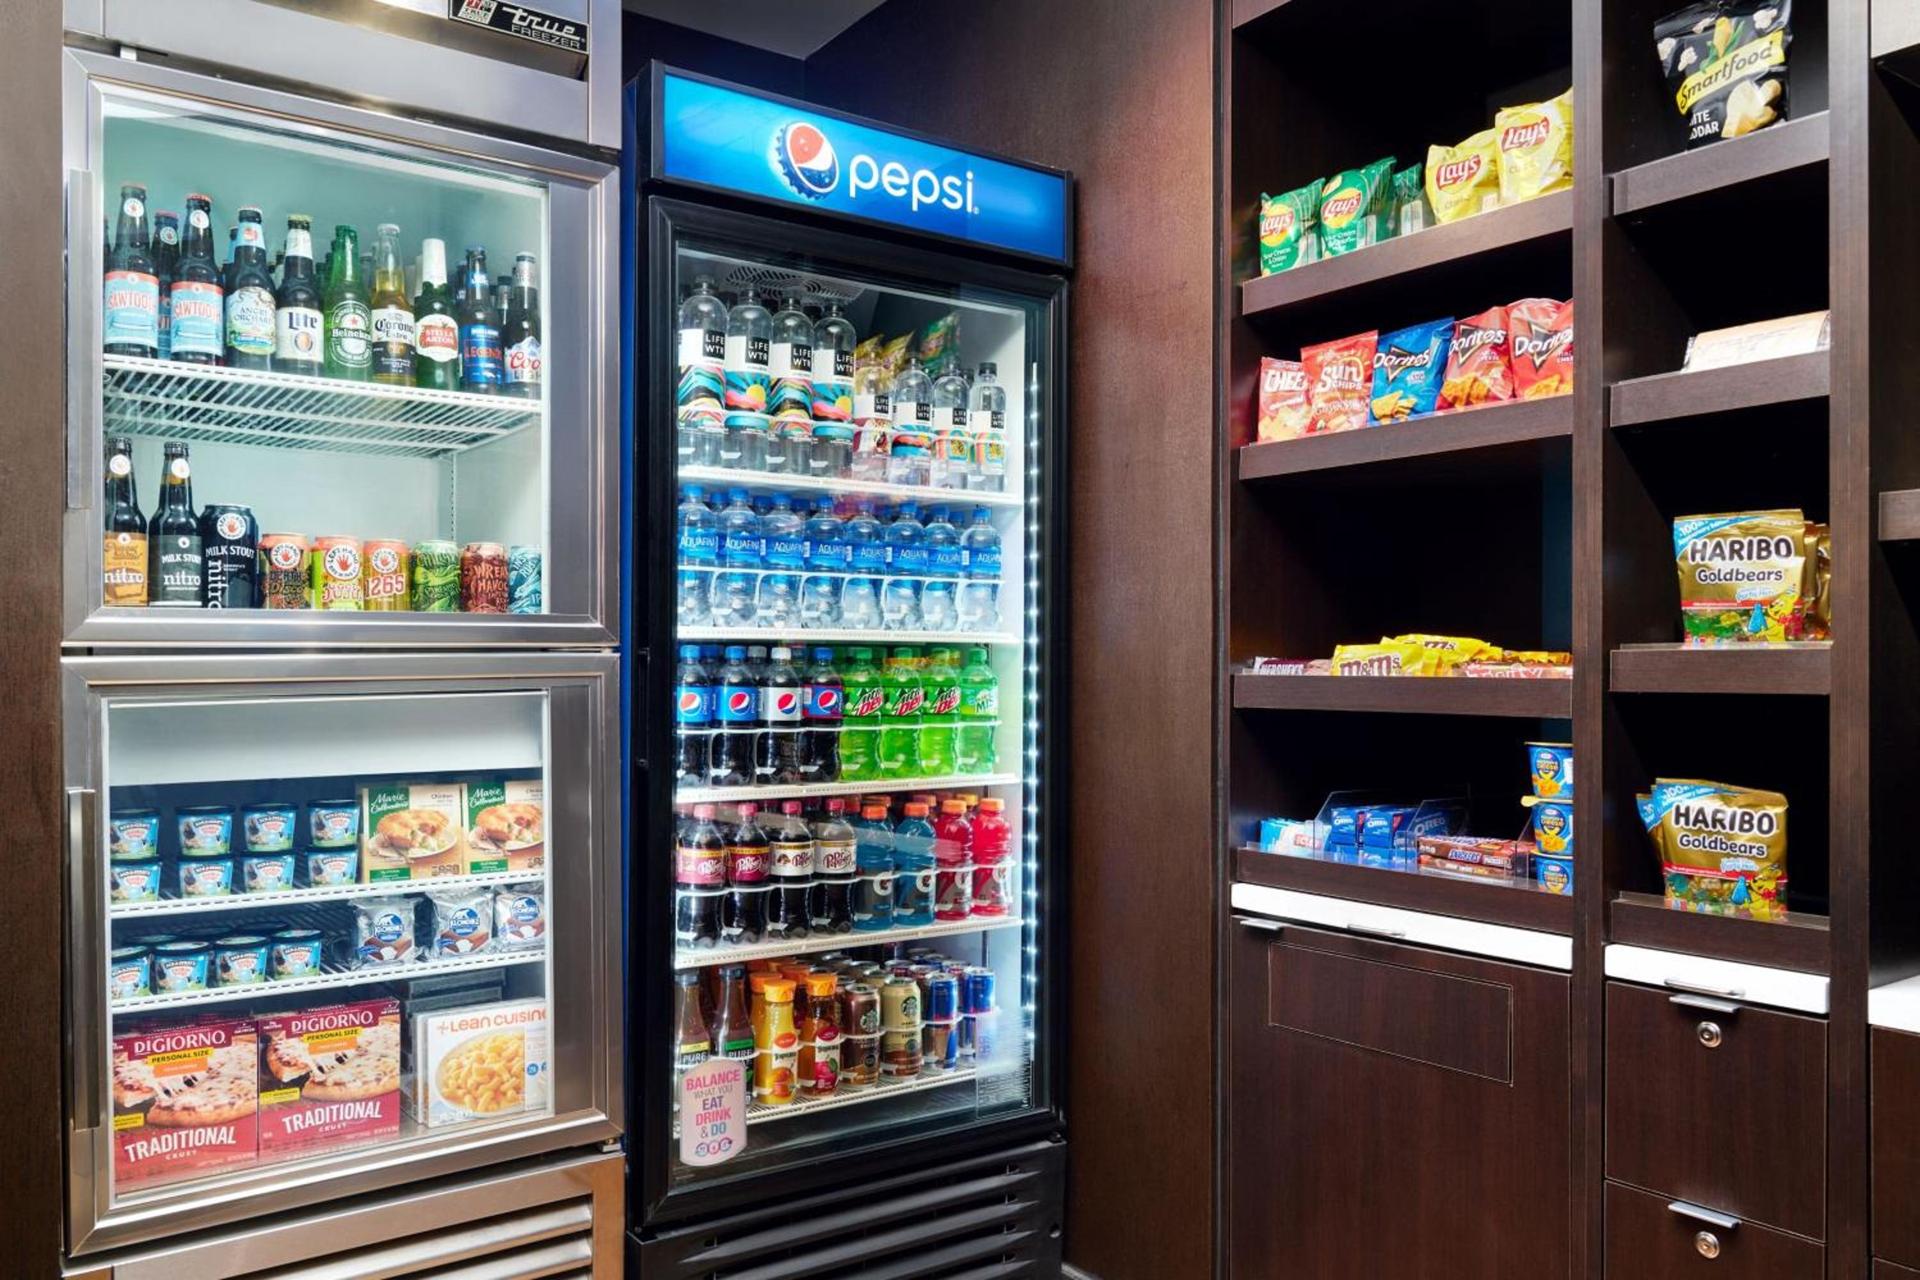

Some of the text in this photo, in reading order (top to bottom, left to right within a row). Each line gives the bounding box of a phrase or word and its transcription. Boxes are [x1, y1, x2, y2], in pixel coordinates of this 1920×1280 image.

[511, 24, 580, 49] FREEZER
[1680, 42, 1774, 110] Smartfood
[1690, 110, 1711, 126] ITE
[849, 154, 974, 215] pepsi
[288, 312, 318, 330] Lite
[705, 333, 725, 345] LIFE
[748, 340, 769, 350] LIFE
[793, 347, 811, 358] LIFE
[836, 353, 854, 364] LIFE
[1374, 349, 1431, 369] Doritos
[206, 545, 255, 559] MILK STOUT
[1690, 537, 1793, 563] HARIBO
[161, 554, 182, 564] MILK
[104, 569, 144, 584] nitro
[163, 570, 201, 586] nitro
[1698, 568, 1784, 583] Goldbears
[208, 560, 229, 609] nitro
[365, 575, 405, 598] 1265
[1674, 804, 1775, 835] HARIBO
[1679, 834, 1766, 857] Goldbears
[290, 1010, 374, 1034] DIGIORNO
[133, 1029, 226, 1057] DIGIORNO
[307, 1028, 360, 1042] PERSONAL SIZE
[151, 1048, 211, 1064] PERSONAL SIZE
[683, 1051, 707, 1064] PURE
[686, 1069, 741, 1091] BALANCE
[694, 1084, 733, 1099] WHAT YOU
[702, 1096, 724, 1111] EAT
[282, 1100, 382, 1135] TRADITIONAL
[695, 1107, 732, 1126] DRINK
[319, 1121, 347, 1134] CRUST
[701, 1122, 727, 1138] & DO
[125, 1126, 236, 1163] TRADITIONAL
[165, 1149, 197, 1161] CRUST
